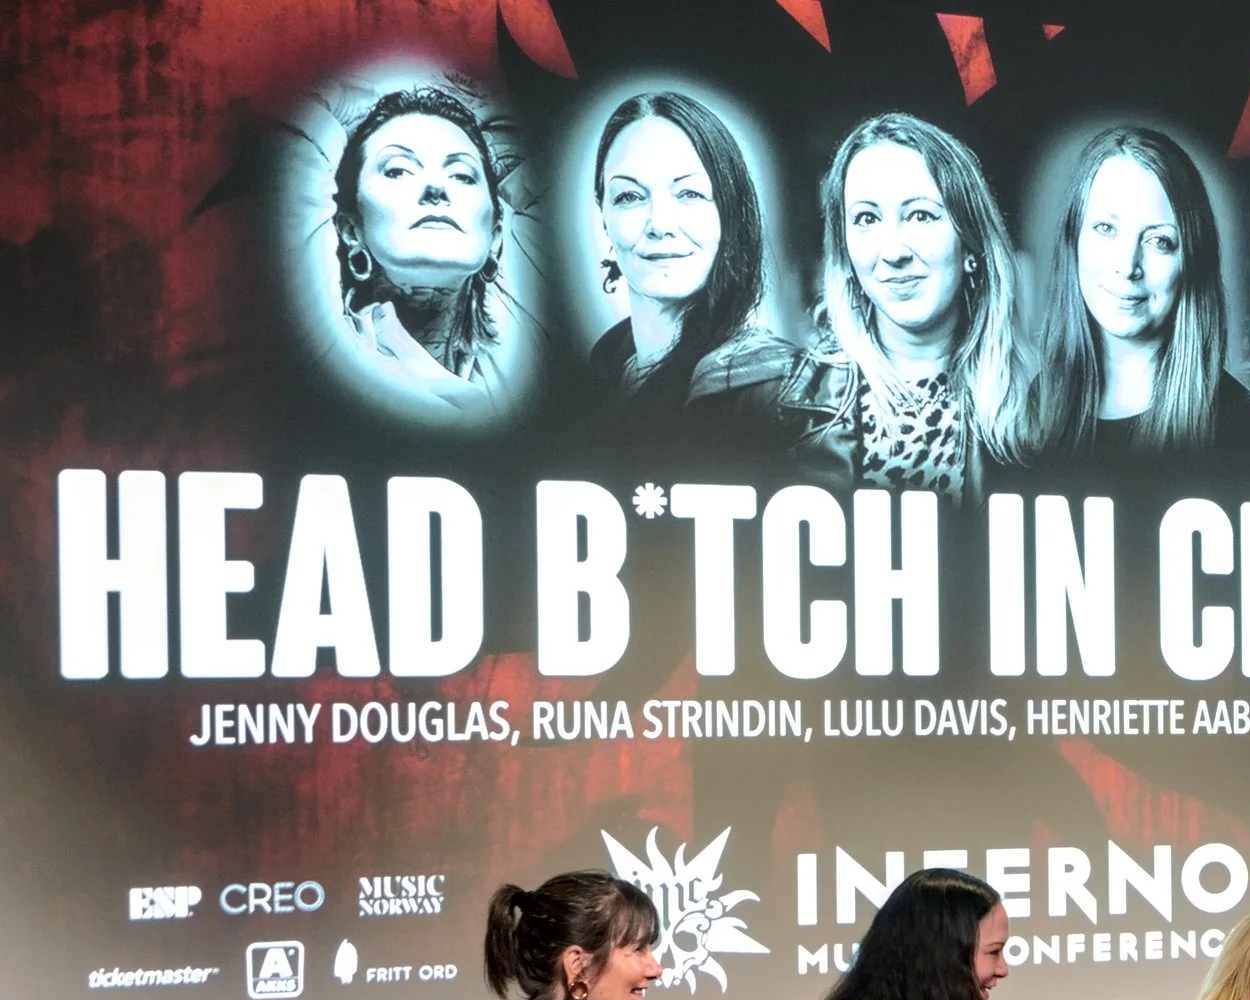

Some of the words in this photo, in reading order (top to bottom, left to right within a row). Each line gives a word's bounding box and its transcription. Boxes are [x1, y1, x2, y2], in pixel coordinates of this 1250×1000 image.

[57, 469, 484, 679] HEAD
[989, 493, 1116, 676] IN
[190, 704, 321, 746] JENNY
[333, 701, 519, 746] DOUGLAS,
[534, 702, 634, 739] RUNA
[643, 700, 812, 742] STRINDIN,
[825, 701, 903, 736] LULU
[915, 699, 1016, 741] DAVIS,
[1028, 700, 1185, 735] HENRIETTE
[220, 880, 325, 914] CREO
[359, 875, 445, 899] MUSIC
[797, 840, 1249, 925] INERNO
[359, 897, 444, 917] NORWAY
[1003, 928, 1227, 967] ONFERENC
[88, 966, 212, 989] ticketmaster
[367, 965, 413, 983] FRITT
[419, 964, 458, 981] ORD
